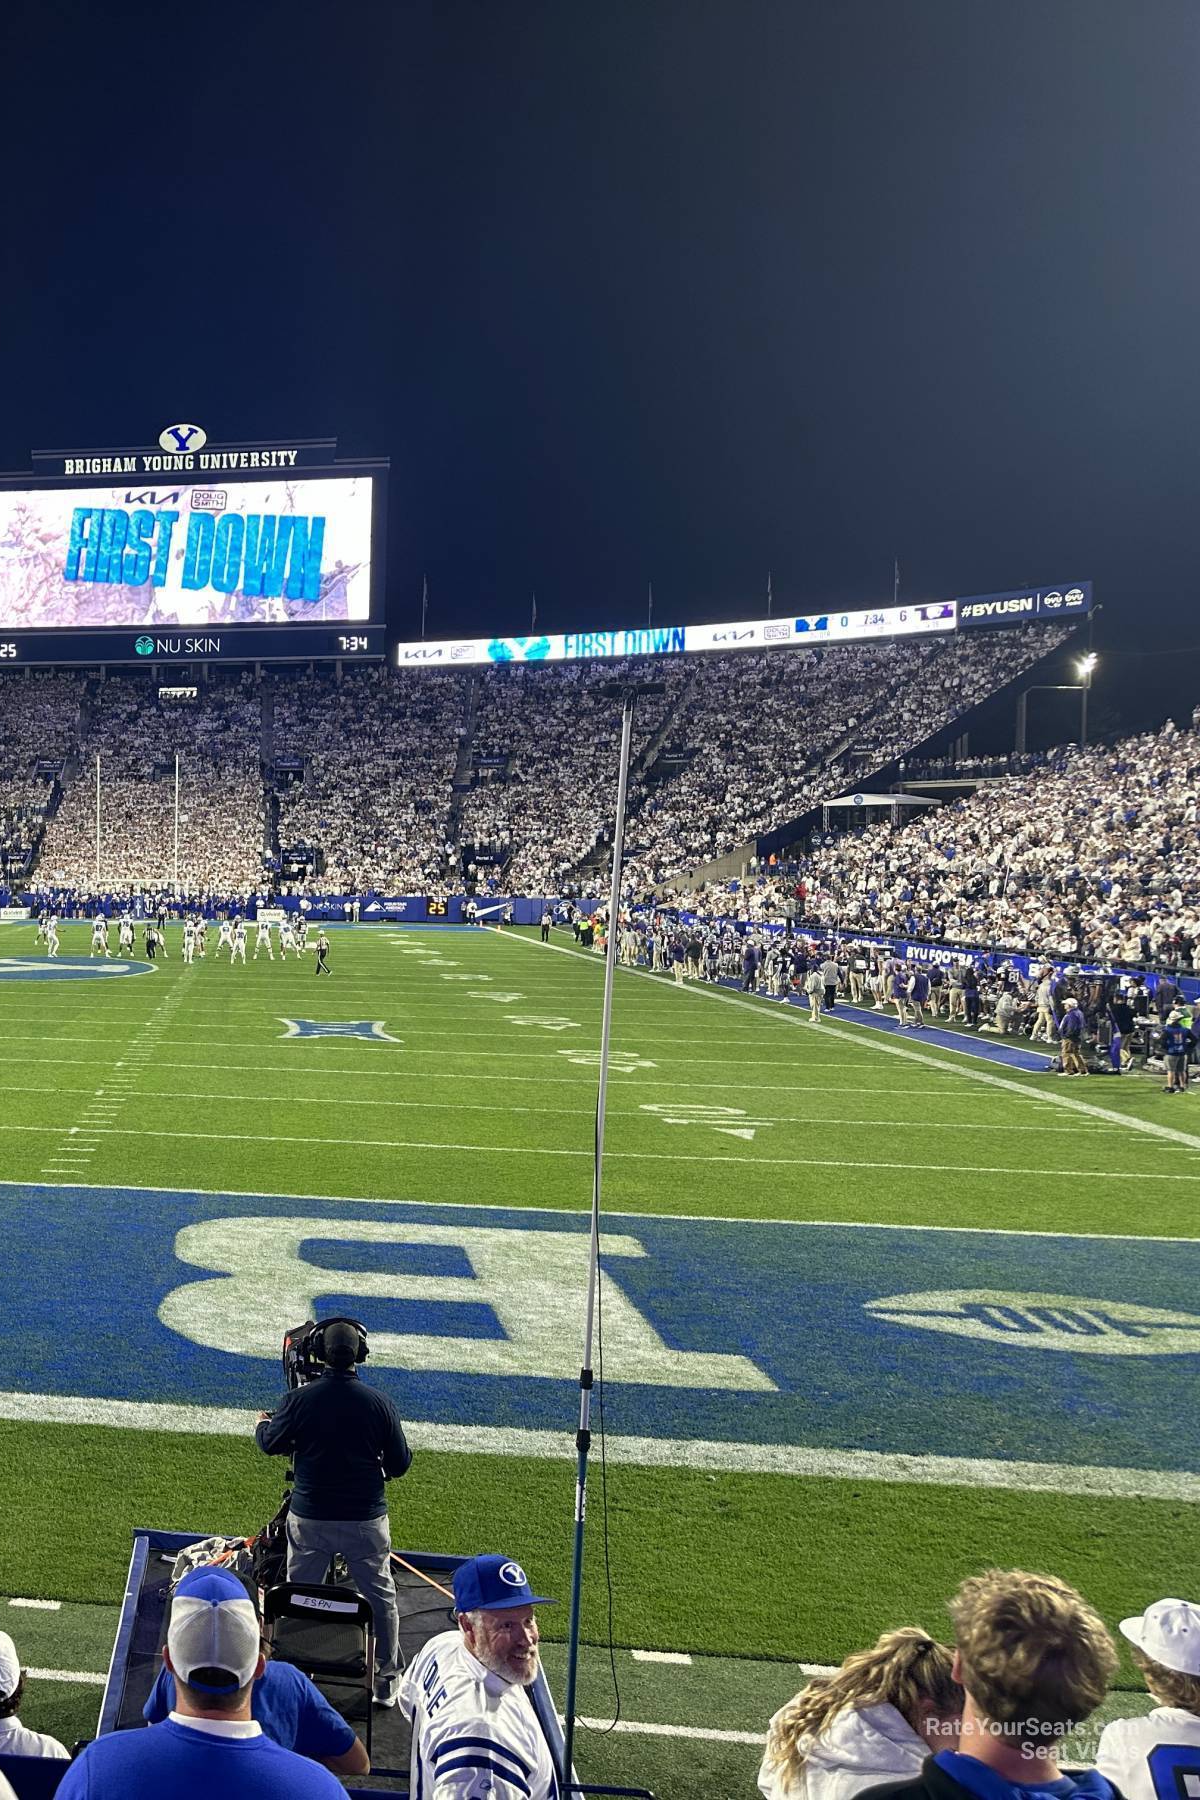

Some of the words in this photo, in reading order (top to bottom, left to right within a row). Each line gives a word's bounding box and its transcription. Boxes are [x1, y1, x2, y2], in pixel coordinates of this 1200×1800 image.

[167, 427, 198, 451] Y
[65, 455, 137, 475] BRIGHAM
[143, 454, 194, 472] YOUNG
[199, 450, 298, 470] UNIVERSITY
[124, 491, 179, 505] KIA
[194, 492, 224, 500] DOUG
[193, 499, 224, 508] SMITH
[63, 507, 178, 587] FIRST
[181, 511, 326, 600] DOWN
[961, 597, 1033, 618] #BYUSN
[840, 615, 849, 628] 0
[863, 613, 885, 626] 7:34
[157, 638, 181, 654] NU
[185, 637, 221, 653] SKIN
[338, 636, 368, 651] 7:34
[564, 631, 618, 658] FIRST
[623, 627, 686, 656] DOWN
[0, 644, 17, 658] 25
[428, 903, 445, 914] 25
[906, 946, 928, 960] BYU
[1008, 971, 1019, 983] 81
[303, 1598, 332, 1609] ESPN
